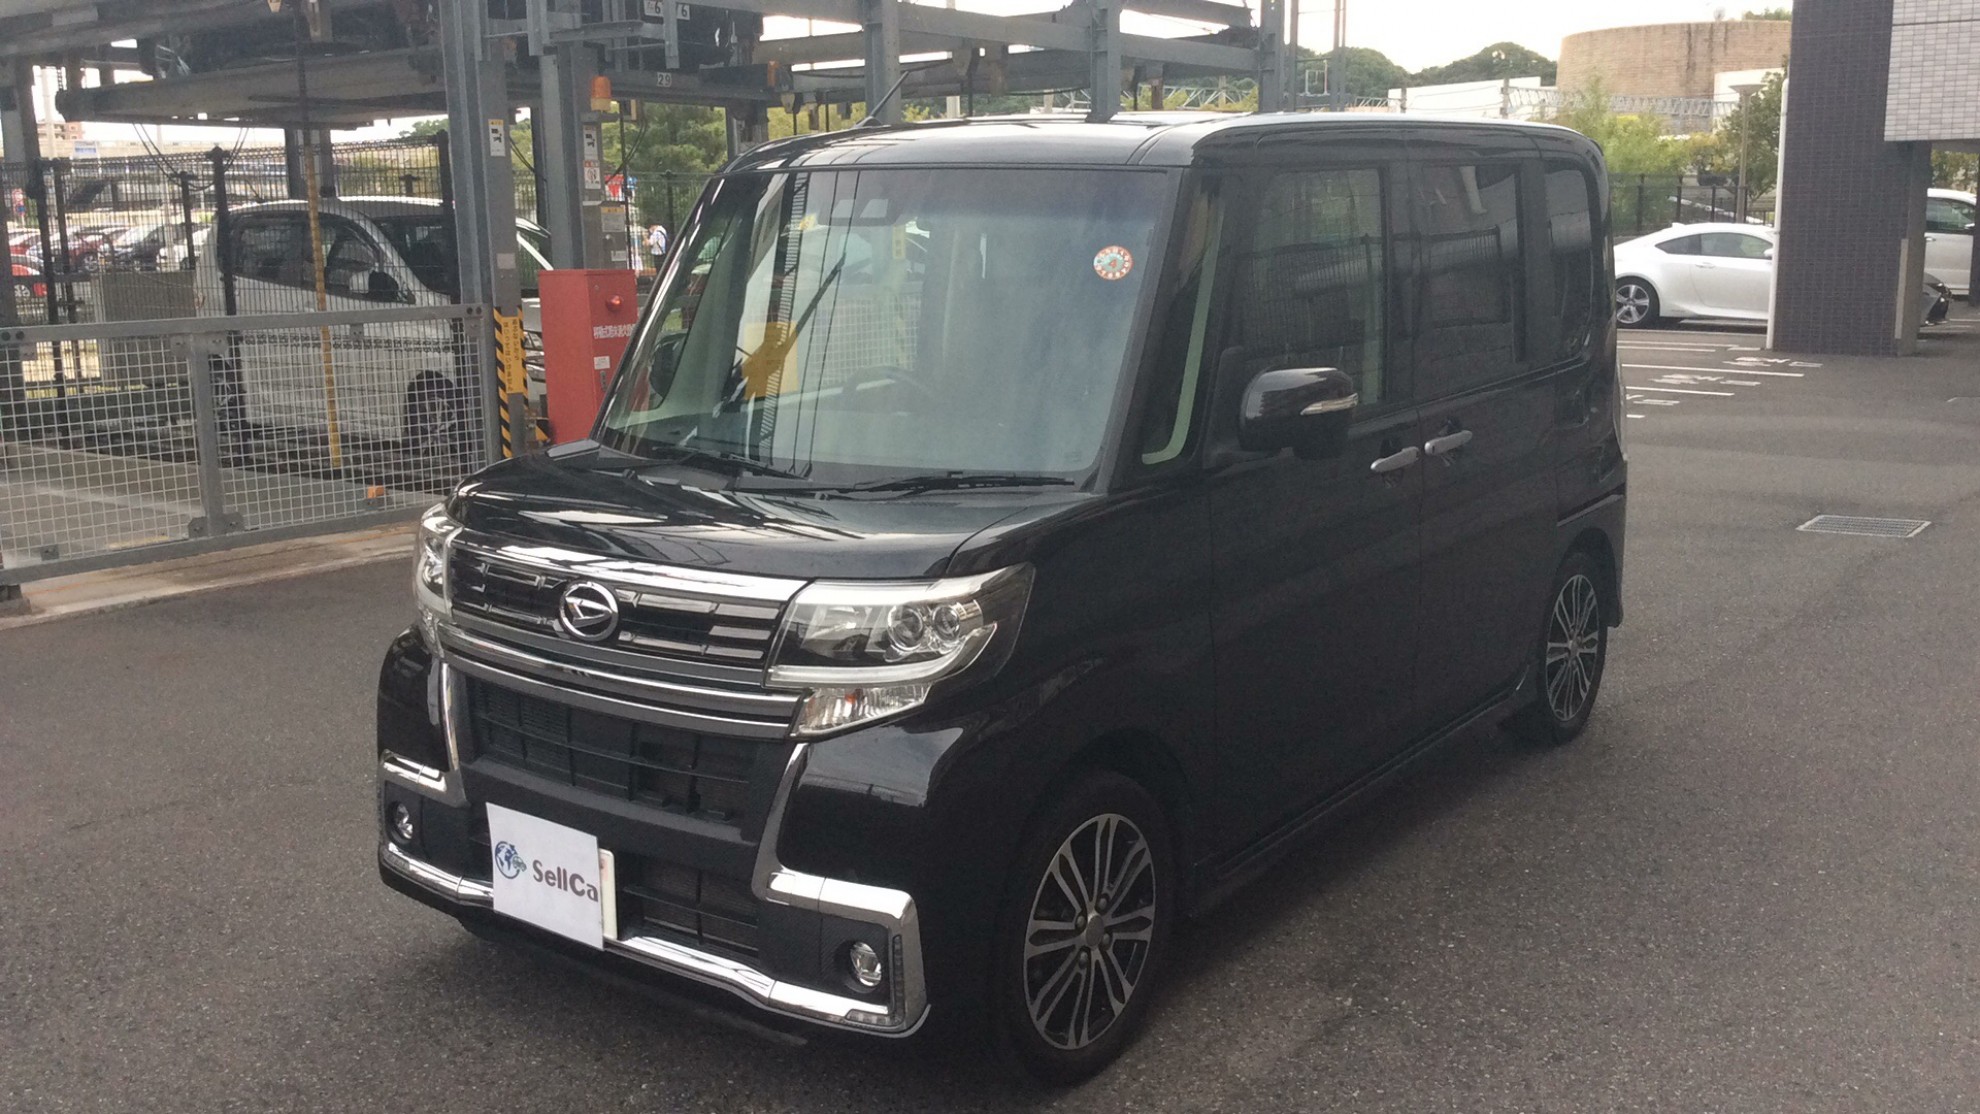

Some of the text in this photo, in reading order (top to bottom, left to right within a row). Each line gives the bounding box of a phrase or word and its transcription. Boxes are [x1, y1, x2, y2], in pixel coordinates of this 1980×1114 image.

[681, 4, 687, 17] 6
[658, 73, 671, 86] 29
[532, 859, 598, 902] SellCa
